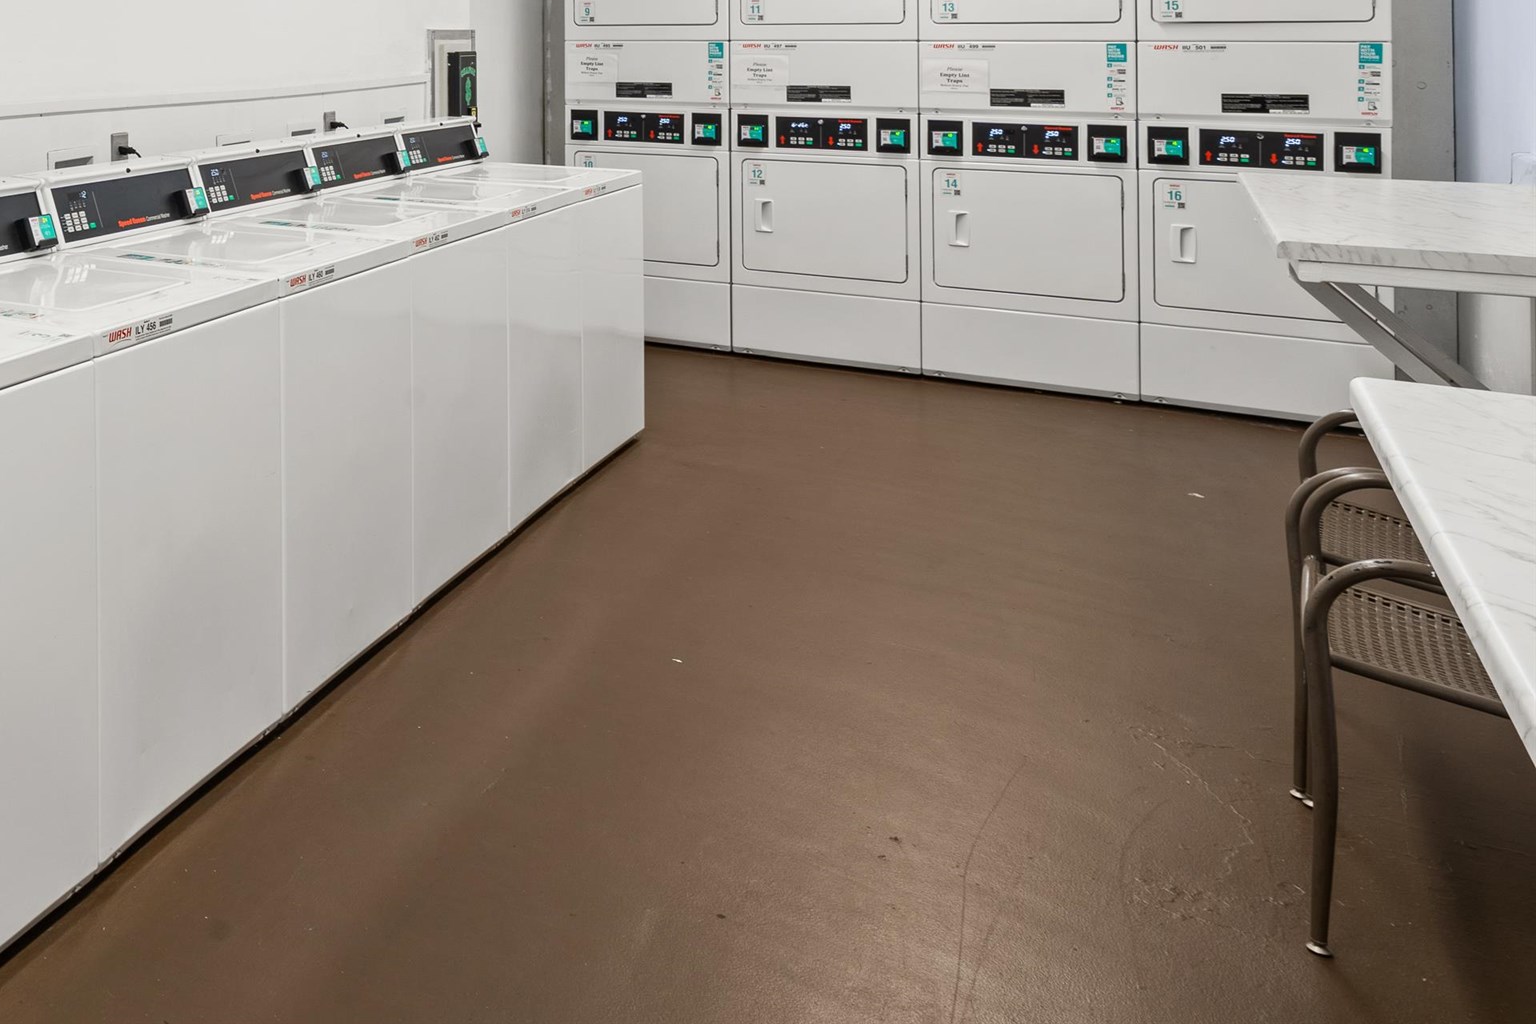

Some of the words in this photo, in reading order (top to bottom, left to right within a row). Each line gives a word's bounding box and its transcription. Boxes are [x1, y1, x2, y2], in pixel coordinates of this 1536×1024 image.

[750, 5, 761, 14] 11
[942, 3, 954, 12] 13
[1165, 0, 1179, 10] 15
[585, 8, 590, 16] 9
[752, 170, 762, 178] 12
[945, 179, 957, 188] 14
[1167, 191, 1182, 201] 16
[109, 327, 132, 342] WASH
